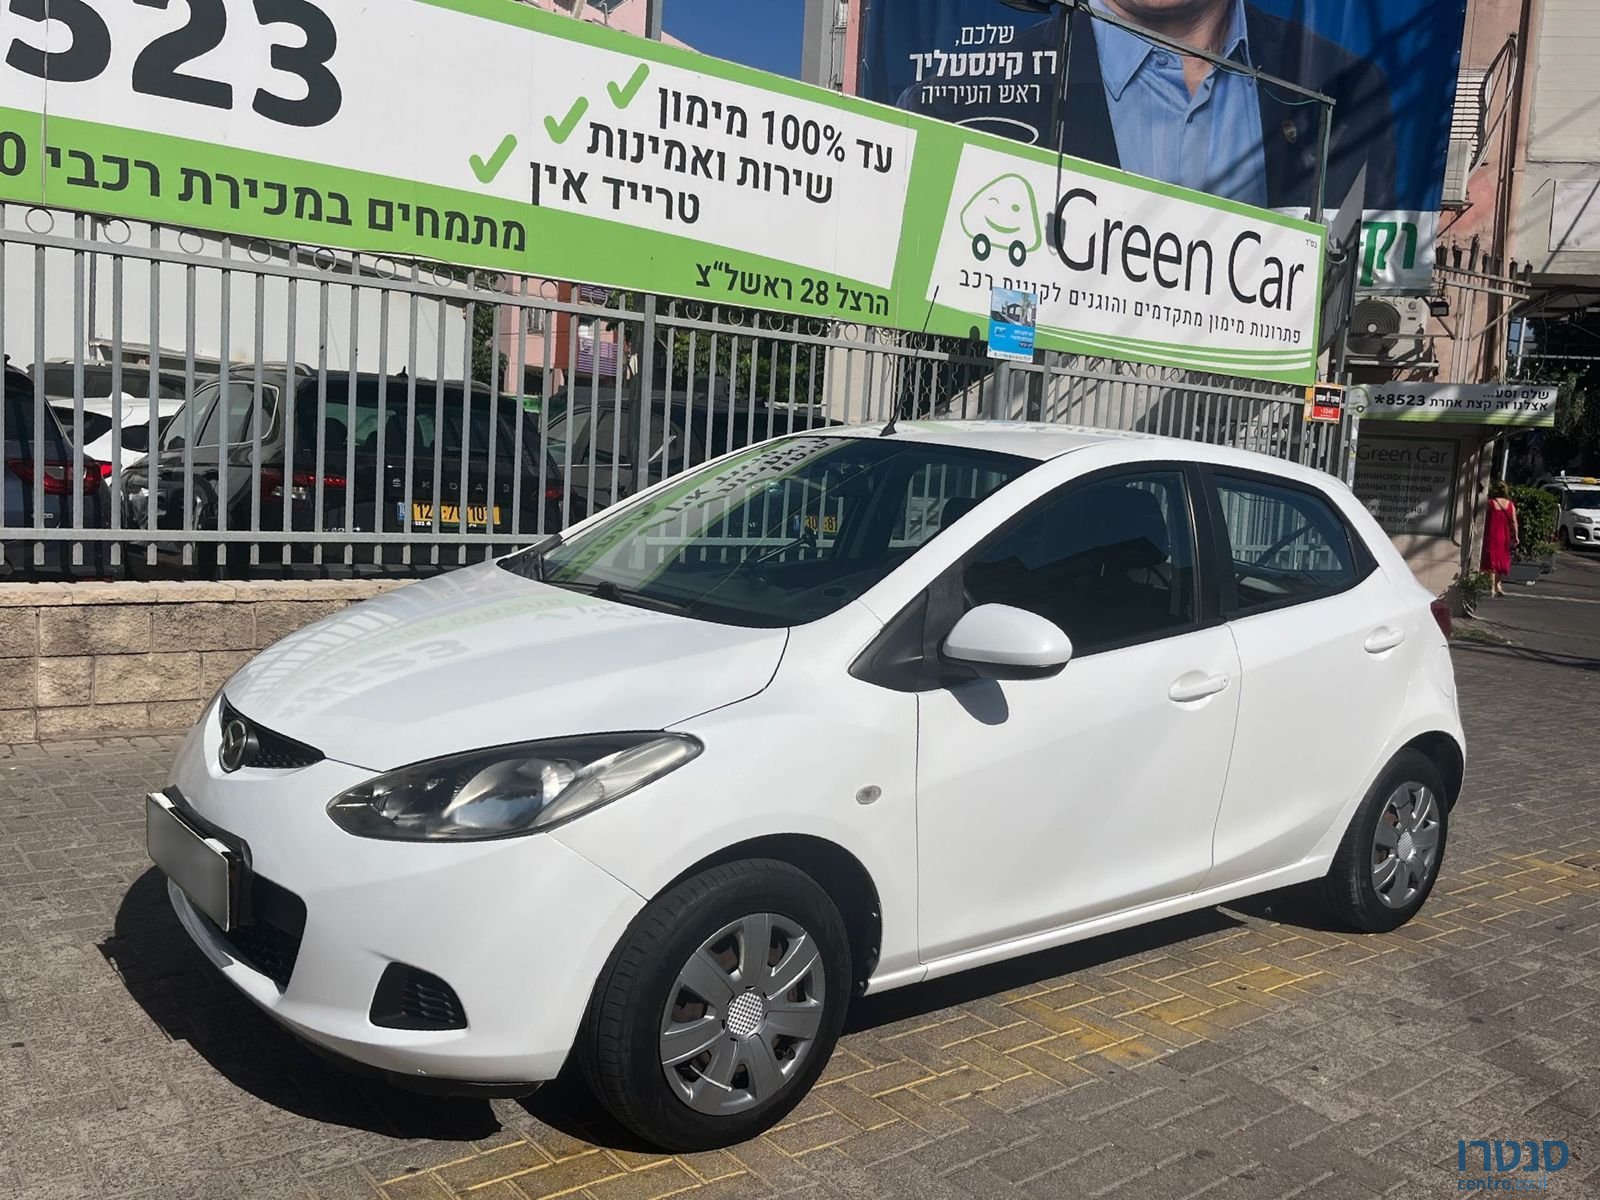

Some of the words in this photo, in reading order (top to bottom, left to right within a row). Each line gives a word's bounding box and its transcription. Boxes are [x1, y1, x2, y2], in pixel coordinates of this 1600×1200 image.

[956, 24, 1014, 46] שלכם,
[910, 50, 1023, 81] קינסטליך
[1033, 51, 1057, 75] רז
[922, 85, 990, 104] העירייה
[999, 85, 1040, 104] ראש
[659, 88, 748, 139] מימון
[762, 110, 847, 163] 100%
[586, 122, 726, 181] ואמינות
[857, 138, 893, 173] עד
[45, 147, 161, 198] רכבי
[530, 161, 589, 207] אין
[736, 157, 833, 204] שירות
[177, 168, 352, 226] במכירת
[602, 175, 700, 224] טרייד
[368, 199, 526, 252] מתמחים
[1054, 188, 1213, 296] Green
[1228, 230, 1305, 311] Car
[800, 278, 829, 306] 28
[959, 269, 993, 291] רכב
[836, 282, 889, 316] הרצל
[1069, 289, 1127, 316] והוגנים
[1134, 301, 1203, 328] מתקדמים
[1209, 314, 1245, 334] מימון
[1249, 323, 1301, 344] פתרונות
[1429, 398, 1462, 408] אחרת
[1466, 399, 1492, 411] קצת
[1482, 389, 1517, 399] וסע...
[1495, 400, 1509, 409] זה
[1513, 400, 1548, 411] אצלנו
[1521, 389, 1549, 400] שלם
[1356, 443, 1411, 462] Green
[1415, 446, 1449, 464] Car
